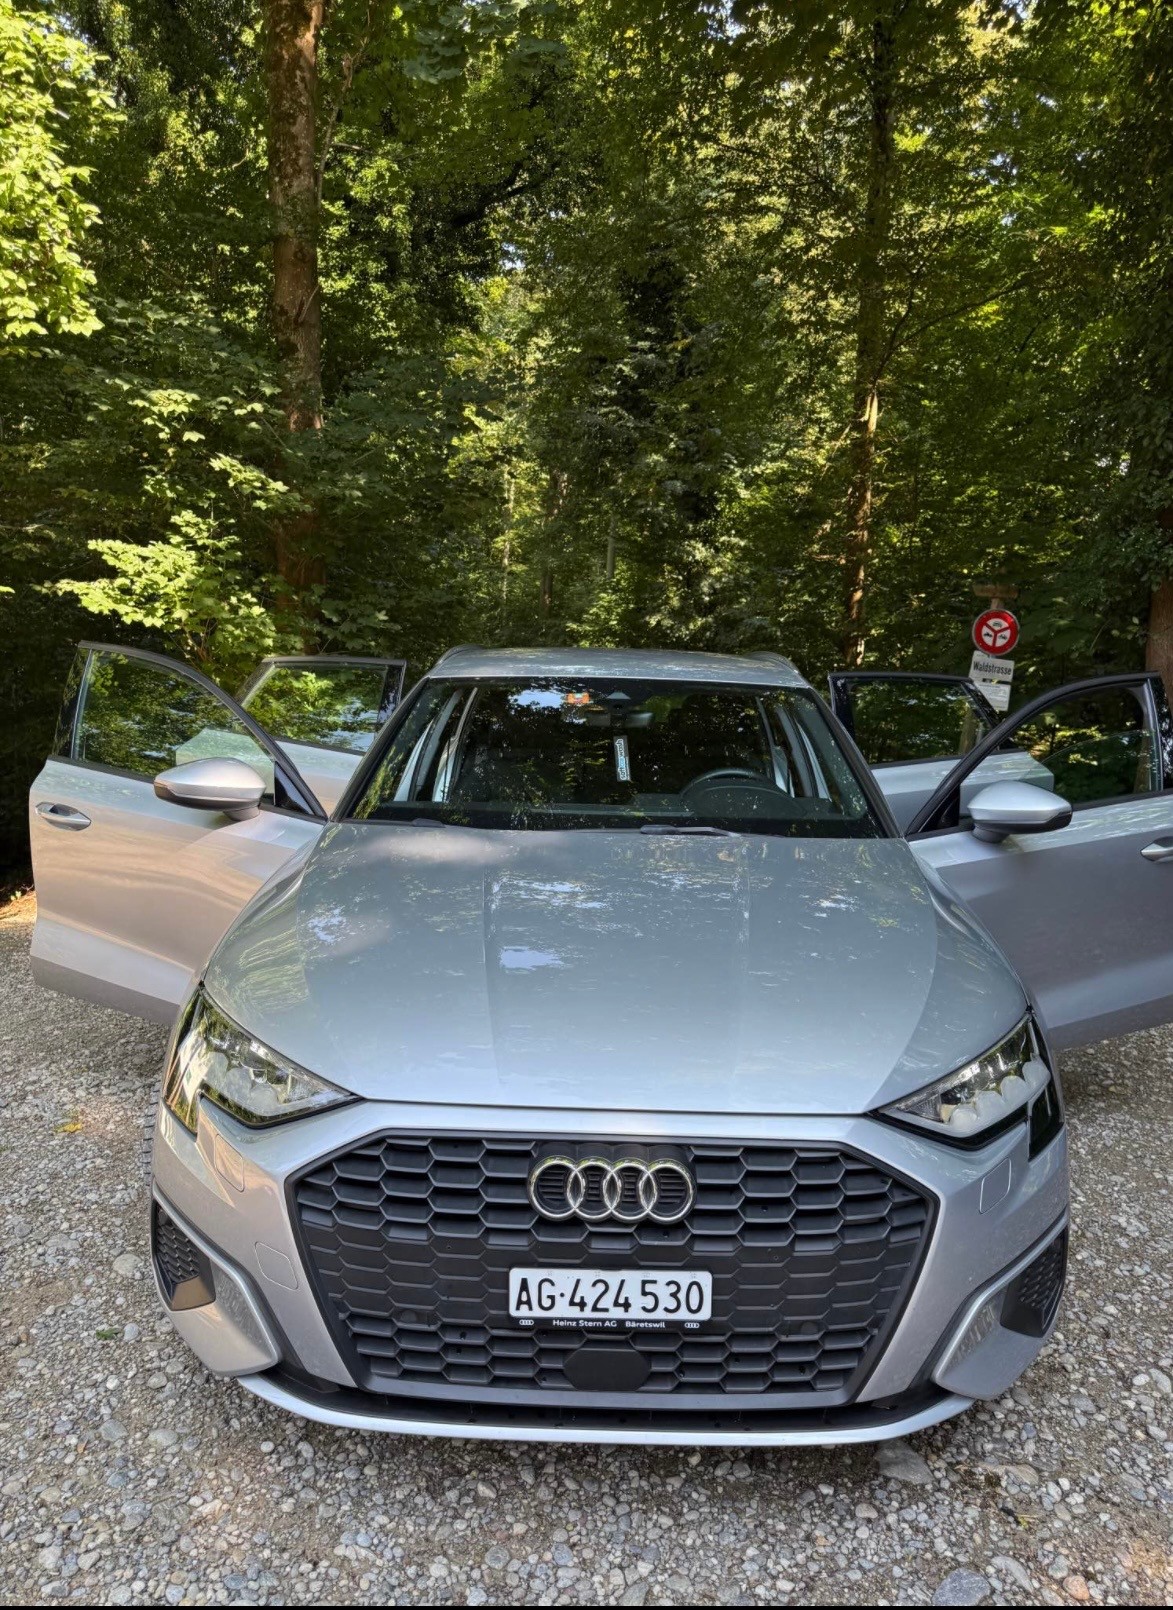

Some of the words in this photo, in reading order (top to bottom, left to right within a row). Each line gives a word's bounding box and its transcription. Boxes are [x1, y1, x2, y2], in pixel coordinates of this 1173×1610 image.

[973, 661, 1012, 676] Waldstrasse
[552, 1319, 577, 1327] Heinz
[625, 1320, 666, 1329] Bäretswil
